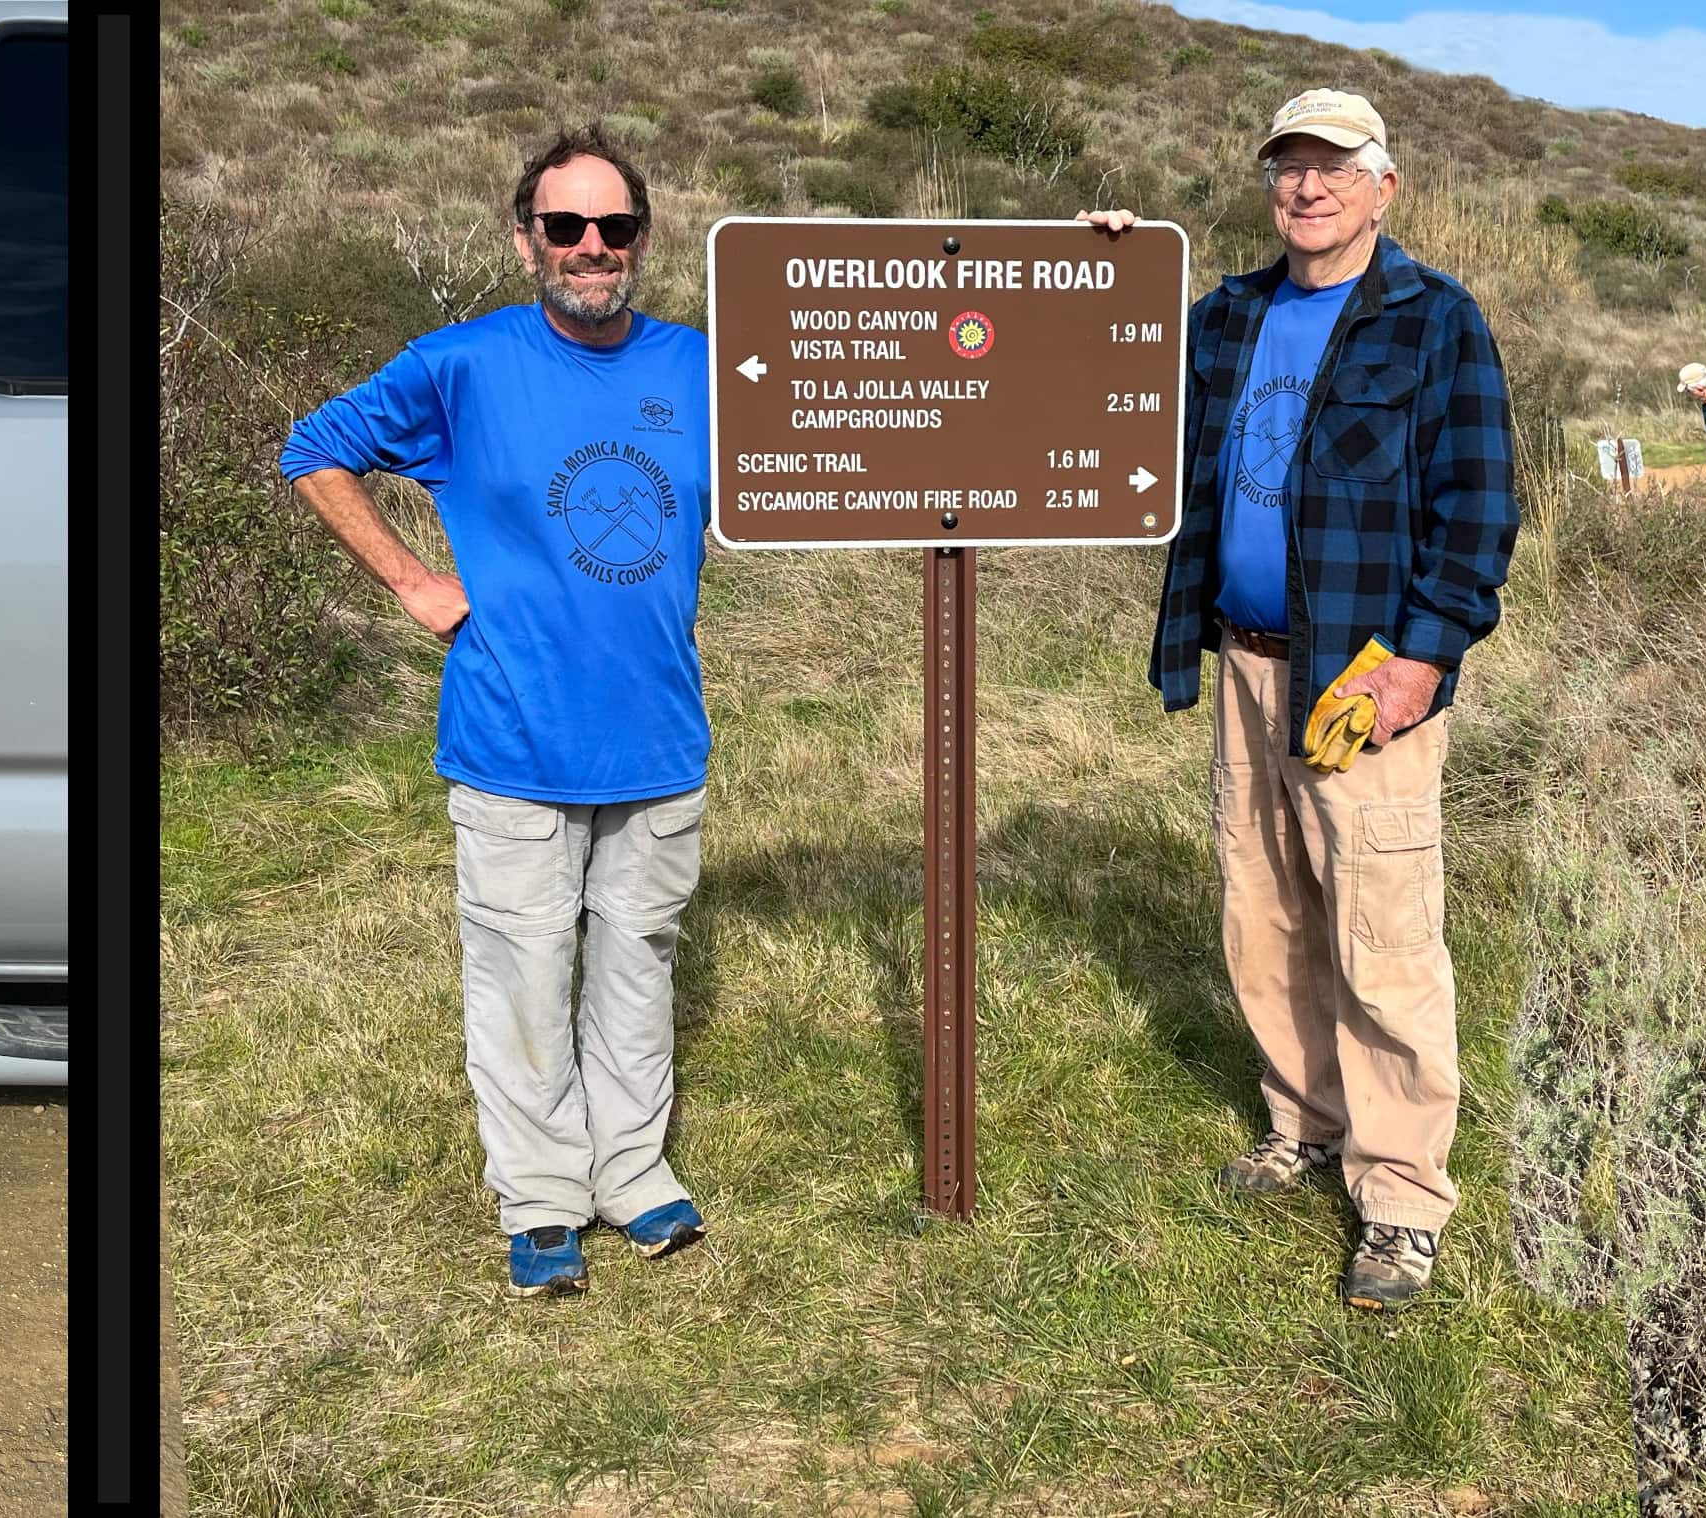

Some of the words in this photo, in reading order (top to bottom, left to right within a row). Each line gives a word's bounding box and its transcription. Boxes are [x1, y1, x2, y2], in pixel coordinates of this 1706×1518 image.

[787, 259, 947, 288] OVERLOOK
[958, 261, 1022, 288] FIRE
[1034, 261, 1114, 289] ROAD
[791, 311, 850, 330] WOOD
[858, 311, 937, 330] CANYON
[1110, 324, 1136, 342] 1.9
[1142, 324, 1162, 342] MI
[791, 340, 845, 359] VISTA
[851, 341, 906, 359] TRAIL
[791, 380, 816, 399] TO
[824, 381, 847, 399] LA
[854, 381, 913, 399] JOLLA
[920, 381, 989, 399] VALLEY
[1253, 375, 1297, 403] MONICA
[1108, 394, 1133, 411] 2.5
[1140, 393, 1159, 411] MI
[792, 409, 941, 428] CAMPGROUNDS
[738, 454, 807, 473] SCENIC
[813, 454, 867, 472] TRAIL
[1048, 450, 1073, 468] 1.6
[1079, 450, 1099, 468] MI
[547, 472, 570, 518] SANTA
[564, 440, 619, 473] MONICA
[623, 444, 677, 519] MOUNTAINS
[738, 492, 838, 511] SYCAMORE
[845, 491, 917, 509] CANYON
[925, 491, 962, 508] FIRE
[969, 490, 1017, 508] ROAD
[1046, 490, 1072, 508] 2.5
[1079, 490, 1098, 507] MI
[567, 547, 613, 584] TRAILS
[617, 550, 669, 586] COUNCIL
